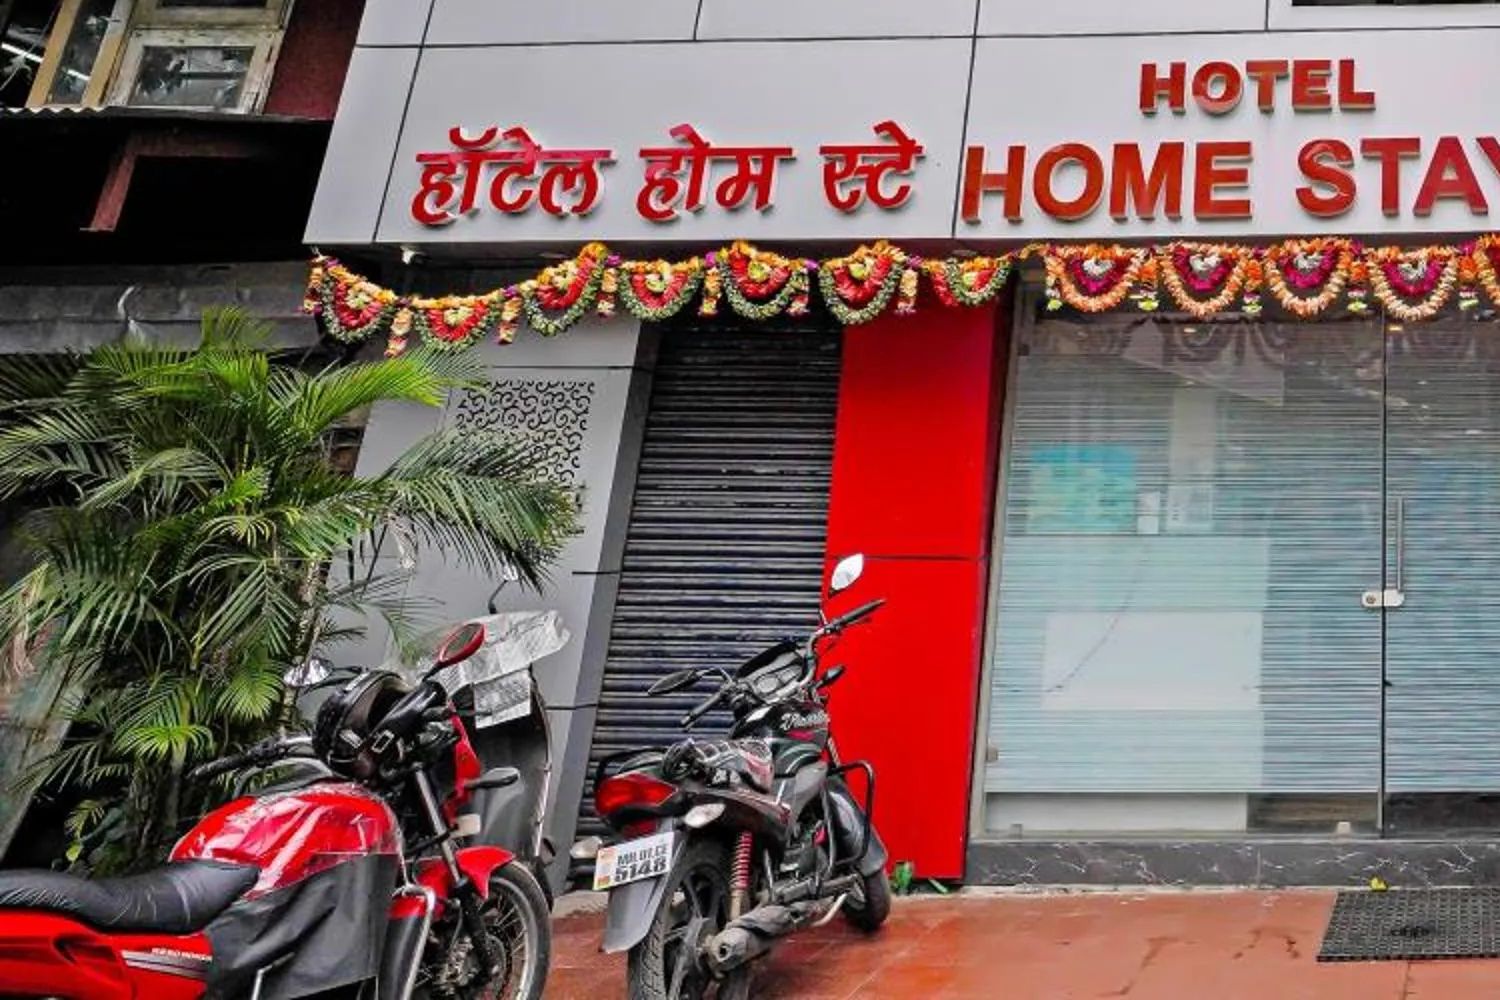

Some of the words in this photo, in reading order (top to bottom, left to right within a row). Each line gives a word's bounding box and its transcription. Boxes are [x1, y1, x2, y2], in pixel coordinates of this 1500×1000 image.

[1139, 58, 1376, 116] HOTEL
[410, 126, 616, 226] हॉटेल
[635, 122, 797, 222] होम
[818, 119, 925, 214] स्टे
[960, 140, 1254, 224] HOME
[614, 855, 668, 883] 5148
